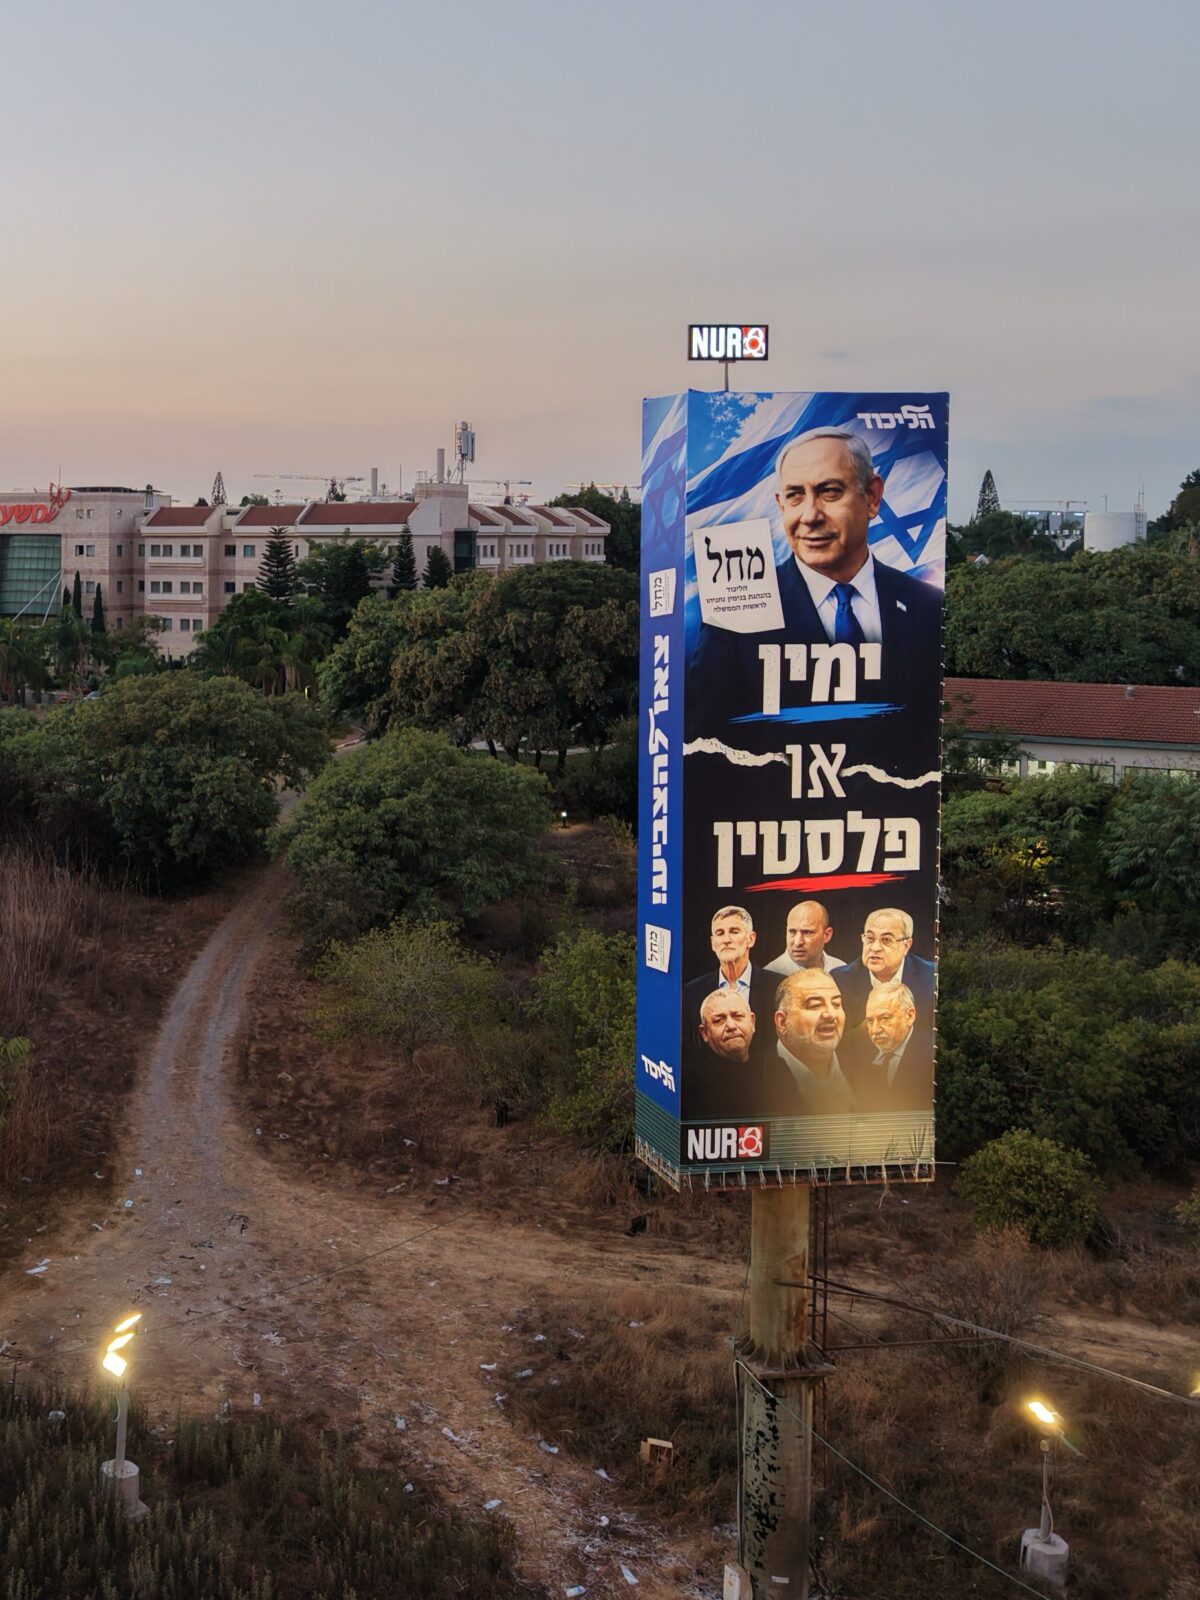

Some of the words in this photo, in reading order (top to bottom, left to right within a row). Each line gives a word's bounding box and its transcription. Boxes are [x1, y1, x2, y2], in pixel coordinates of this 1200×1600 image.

[856, 404, 936, 430] הליכוד
[704, 536, 766, 583] מחל
[726, 585, 748, 593] הליכוד
[653, 634, 670, 715] צאו
[758, 642, 883, 715] ימין
[785, 743, 847, 799] או
[648, 707, 669, 905] להצביע!
[713, 810, 921, 888] פלסטין
